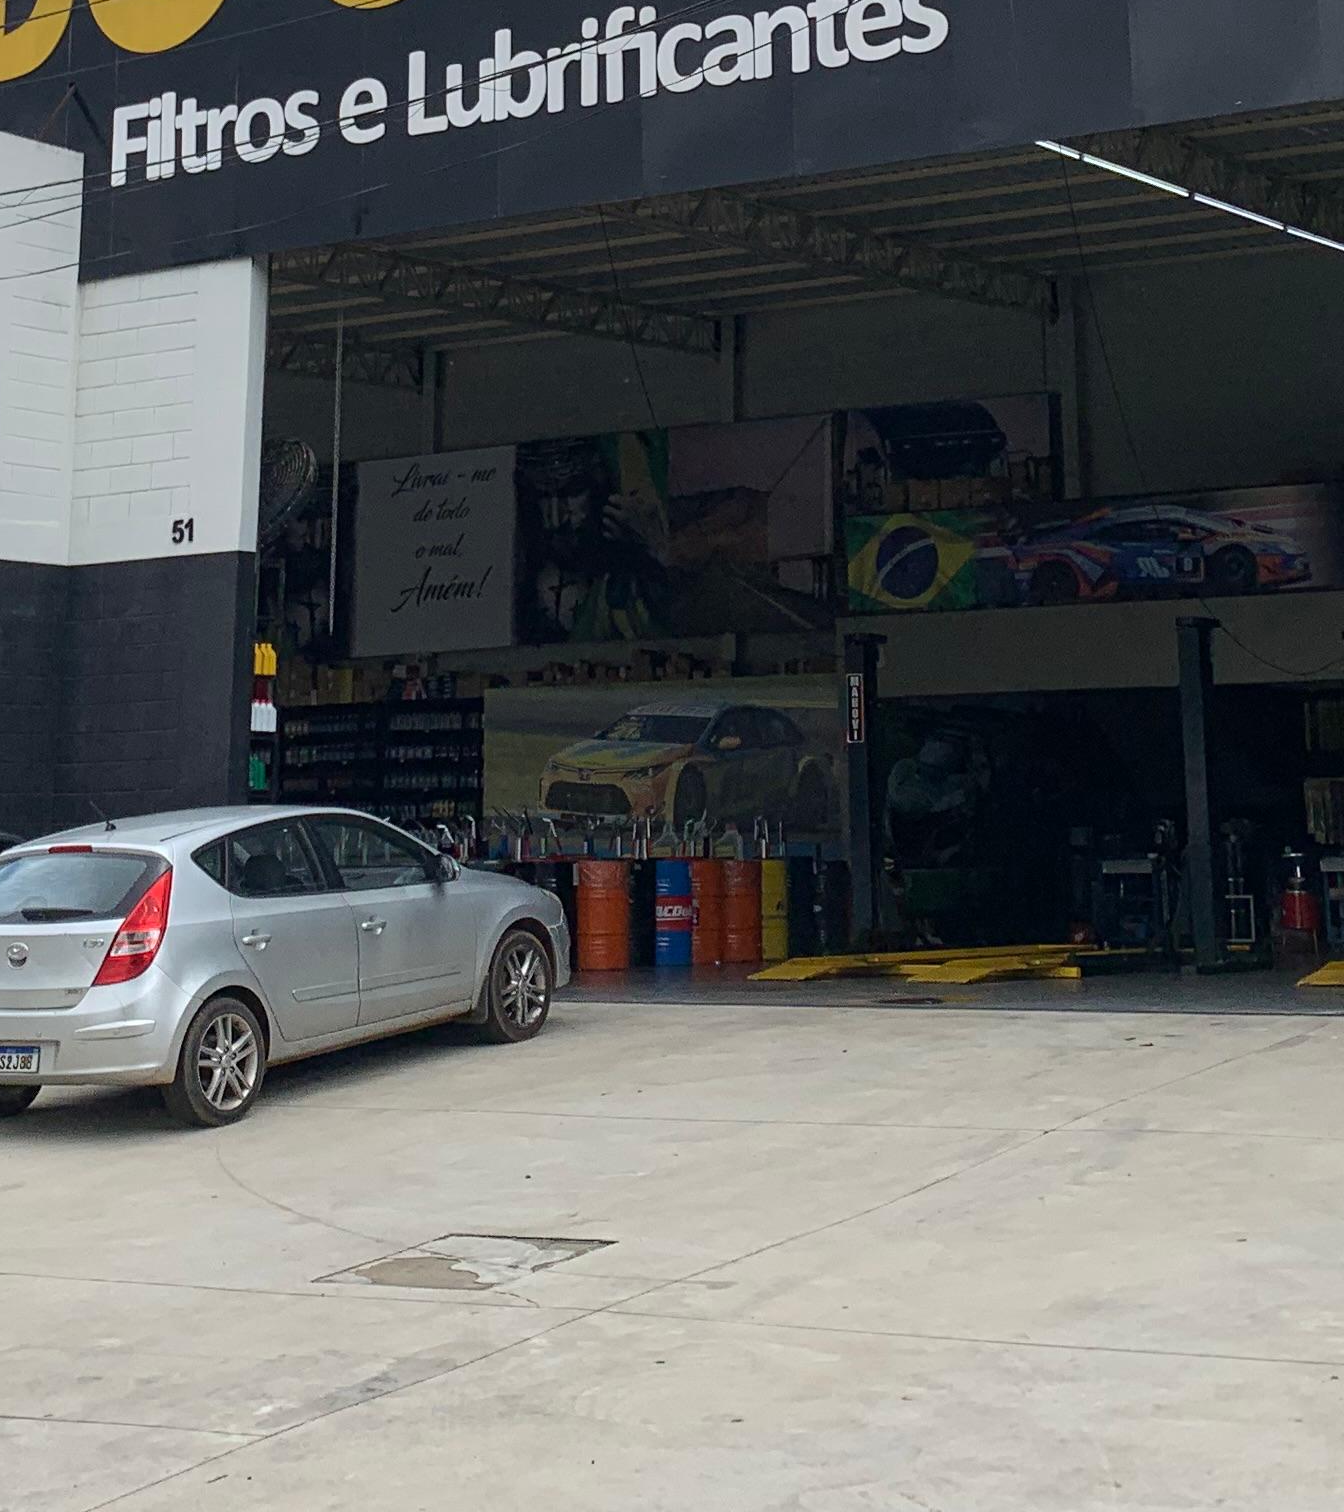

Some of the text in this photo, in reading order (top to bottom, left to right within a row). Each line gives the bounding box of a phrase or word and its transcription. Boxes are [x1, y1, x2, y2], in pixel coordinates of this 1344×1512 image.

[110, 90, 320, 187] Filtros
[339, 78, 388, 144] e
[413, 496, 471, 522] de todo
[171, 517, 194, 544] 51
[415, 544, 426, 559] o
[390, 566, 493, 613] Amém!
